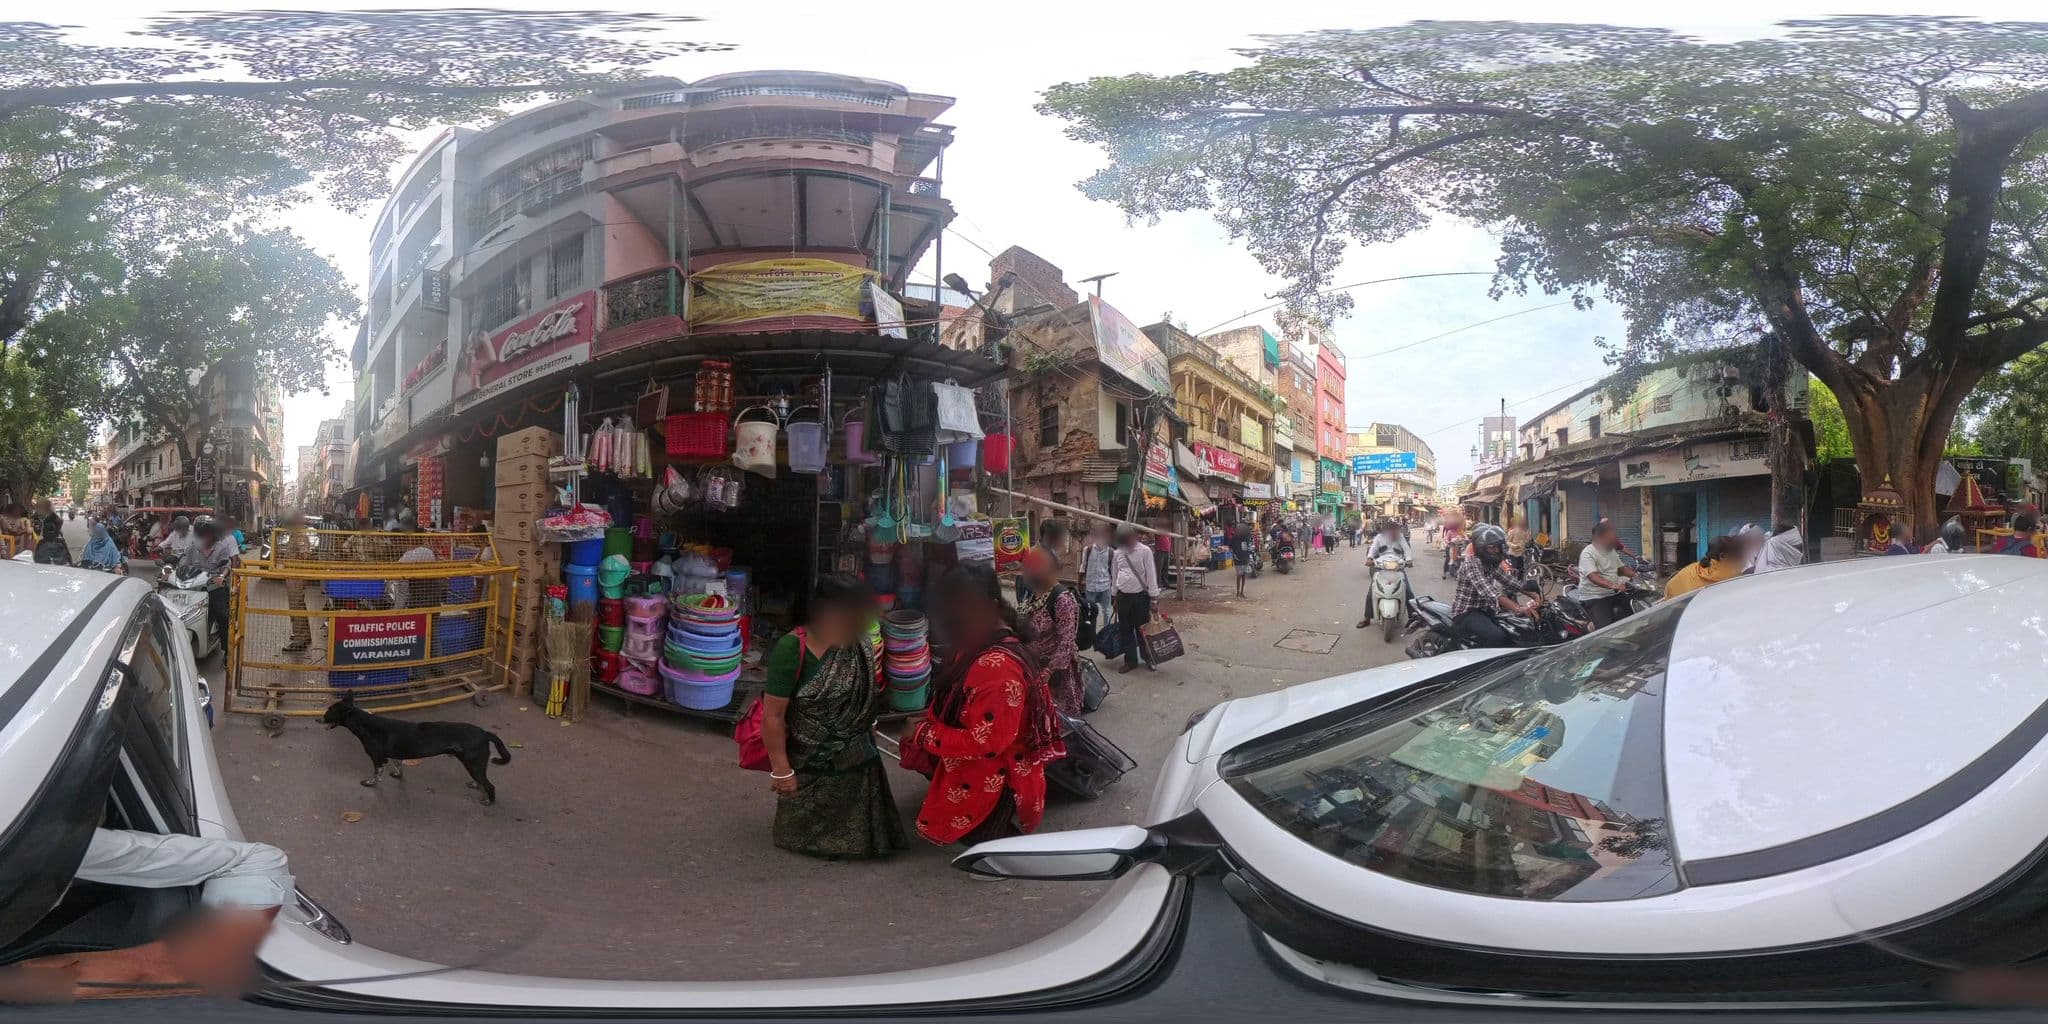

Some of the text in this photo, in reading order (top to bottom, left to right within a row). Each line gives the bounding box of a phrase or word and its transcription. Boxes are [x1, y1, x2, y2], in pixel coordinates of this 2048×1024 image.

[499, 301, 584, 362] Coca-Cola
[478, 379, 507, 399] GENERAL
[508, 368, 533, 386] STORE
[348, 621, 416, 634] TRAFFIC POLICE
[343, 636, 417, 648] COMMISSIONERATE
[353, 649, 411, 660] VARANASI
